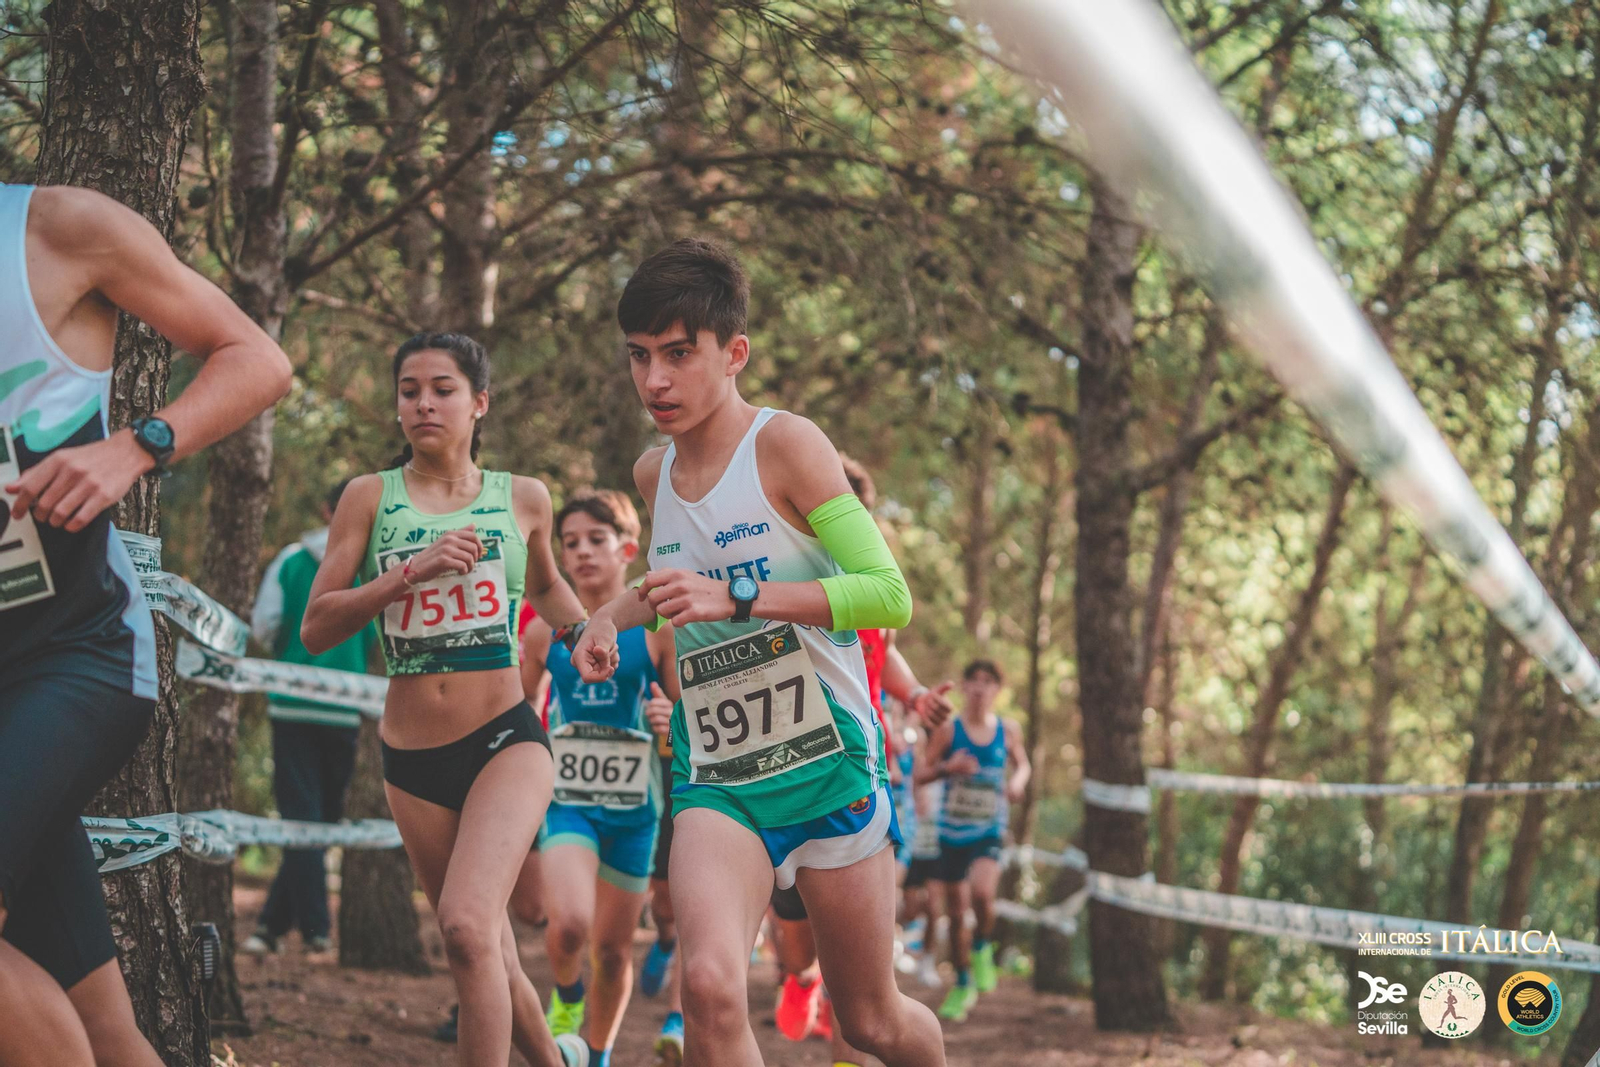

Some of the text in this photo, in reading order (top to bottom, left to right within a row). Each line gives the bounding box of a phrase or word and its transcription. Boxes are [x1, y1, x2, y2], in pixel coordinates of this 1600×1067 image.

[656, 543, 681, 556] FASTER
[714, 522, 771, 548] Beiman
[395, 580, 500, 631] 7513
[697, 641, 762, 673] ITÁLICA
[742, 660, 778, 677] ALEJANDRO
[695, 674, 805, 753] 5977
[559, 753, 642, 783] 8067
